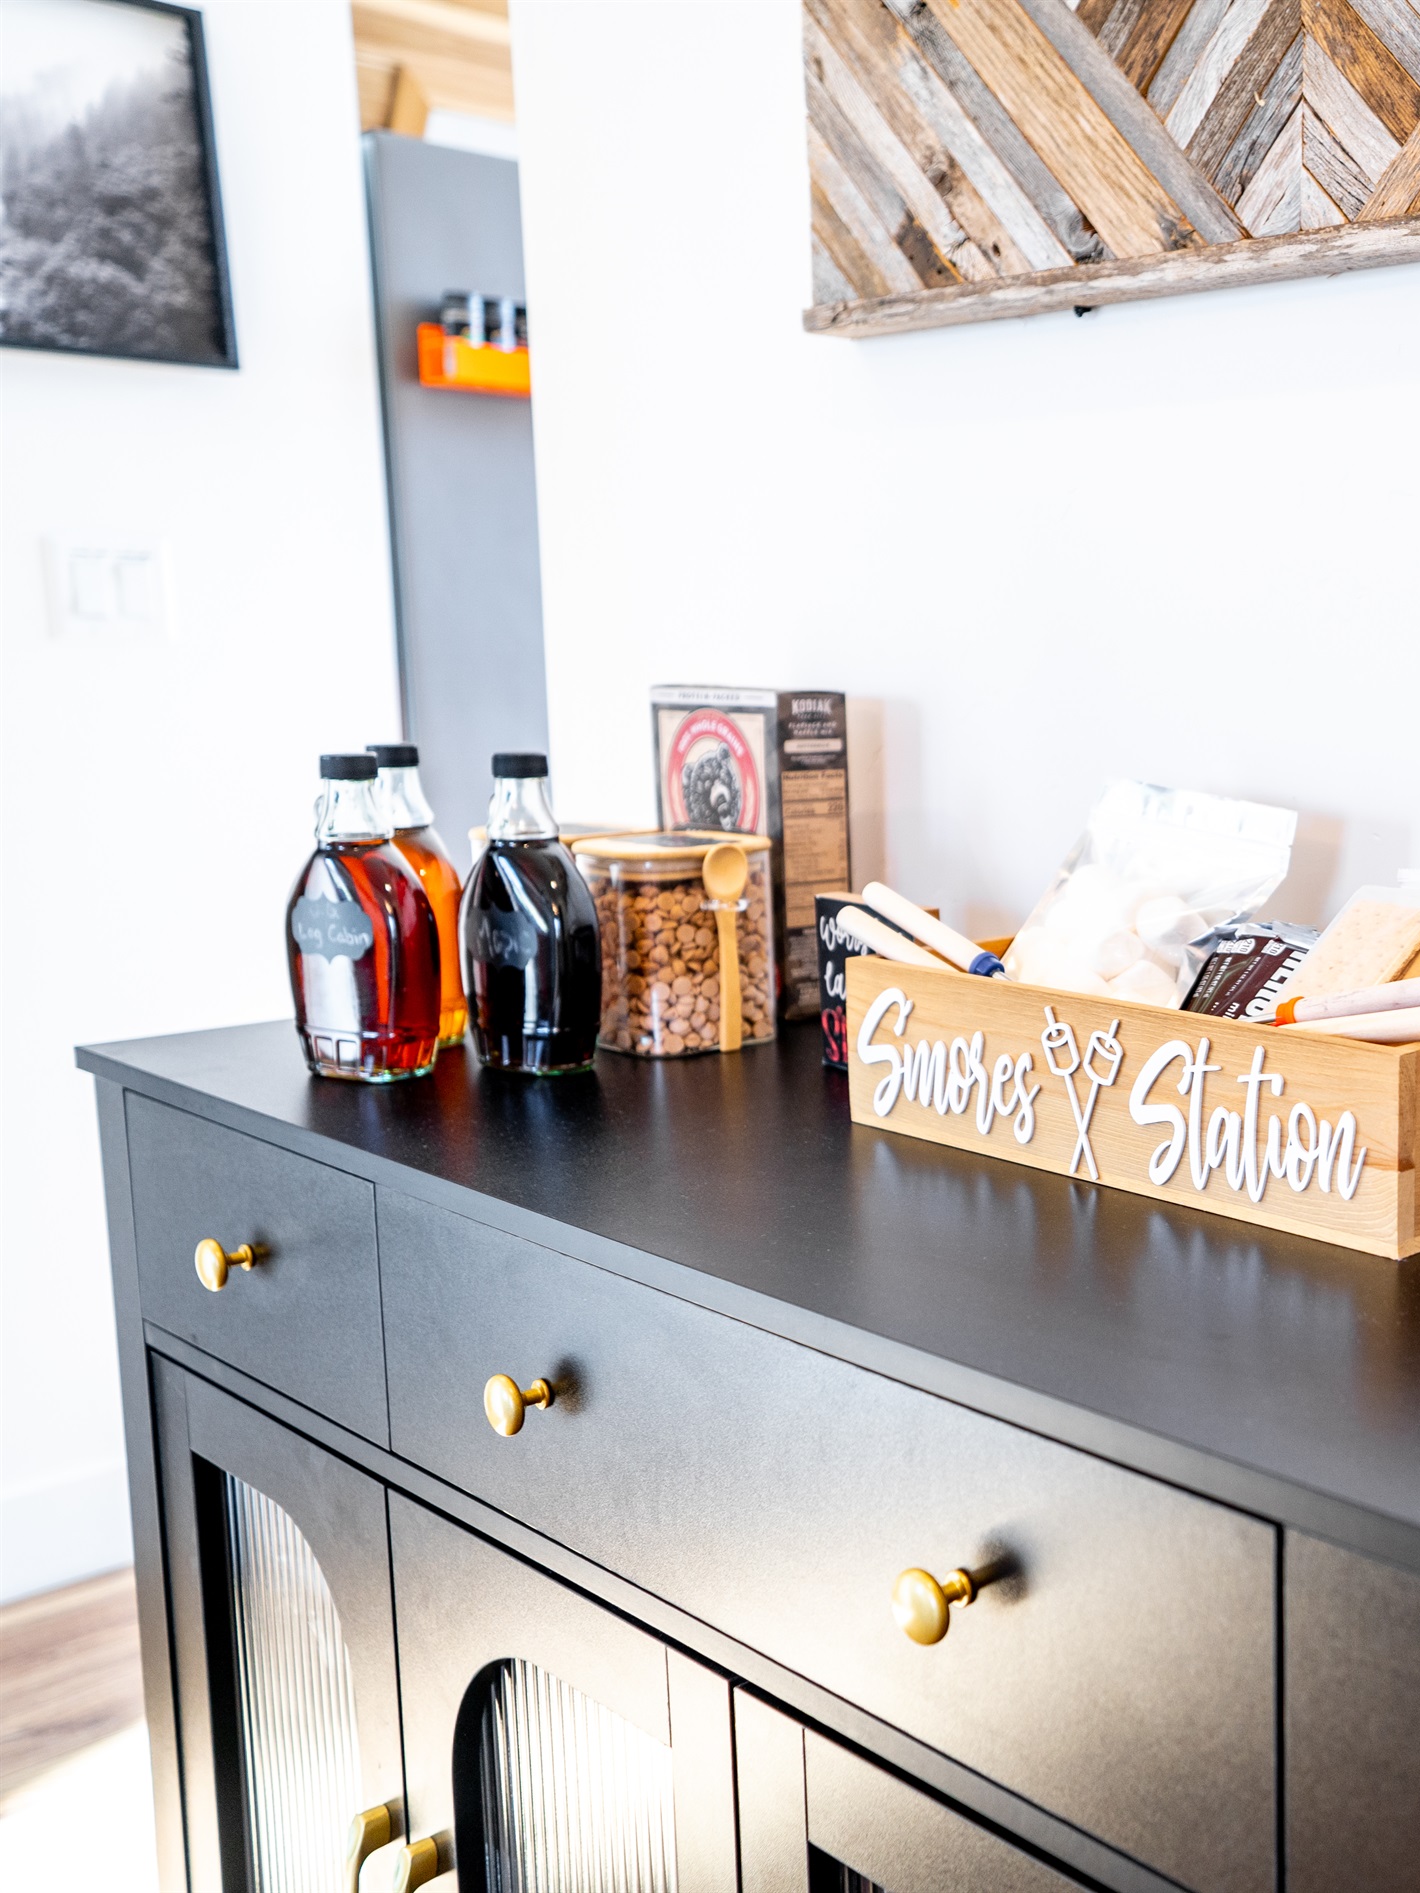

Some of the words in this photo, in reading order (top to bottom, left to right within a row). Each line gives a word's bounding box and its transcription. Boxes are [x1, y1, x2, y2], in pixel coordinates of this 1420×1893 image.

[791, 698, 832, 715] KODIAK
[328, 923, 370, 949] Cabin
[857, 988, 1041, 1145] Smores
[1129, 1037, 1368, 1203] Station
